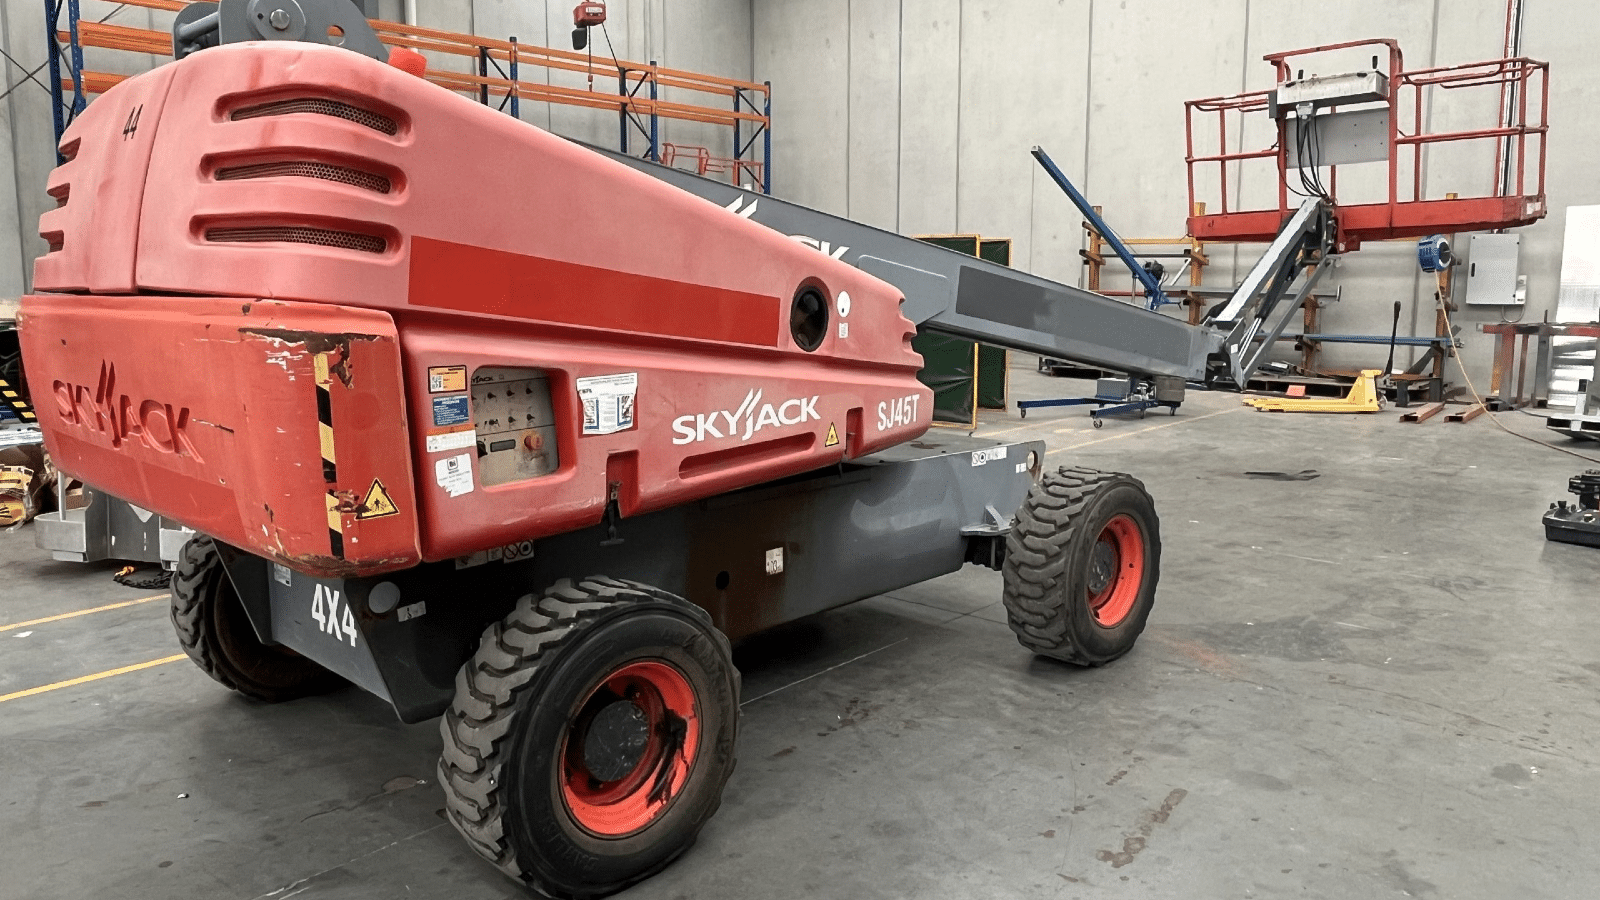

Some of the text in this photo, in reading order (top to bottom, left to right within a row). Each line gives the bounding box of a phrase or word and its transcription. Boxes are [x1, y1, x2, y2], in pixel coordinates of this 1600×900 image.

[122, 103, 144, 142] 44
[52, 358, 205, 465] SKYJACK
[671, 387, 822, 445] SKYJACK
[876, 393, 921, 432] SJ45T
[311, 583, 358, 648] 4X4
